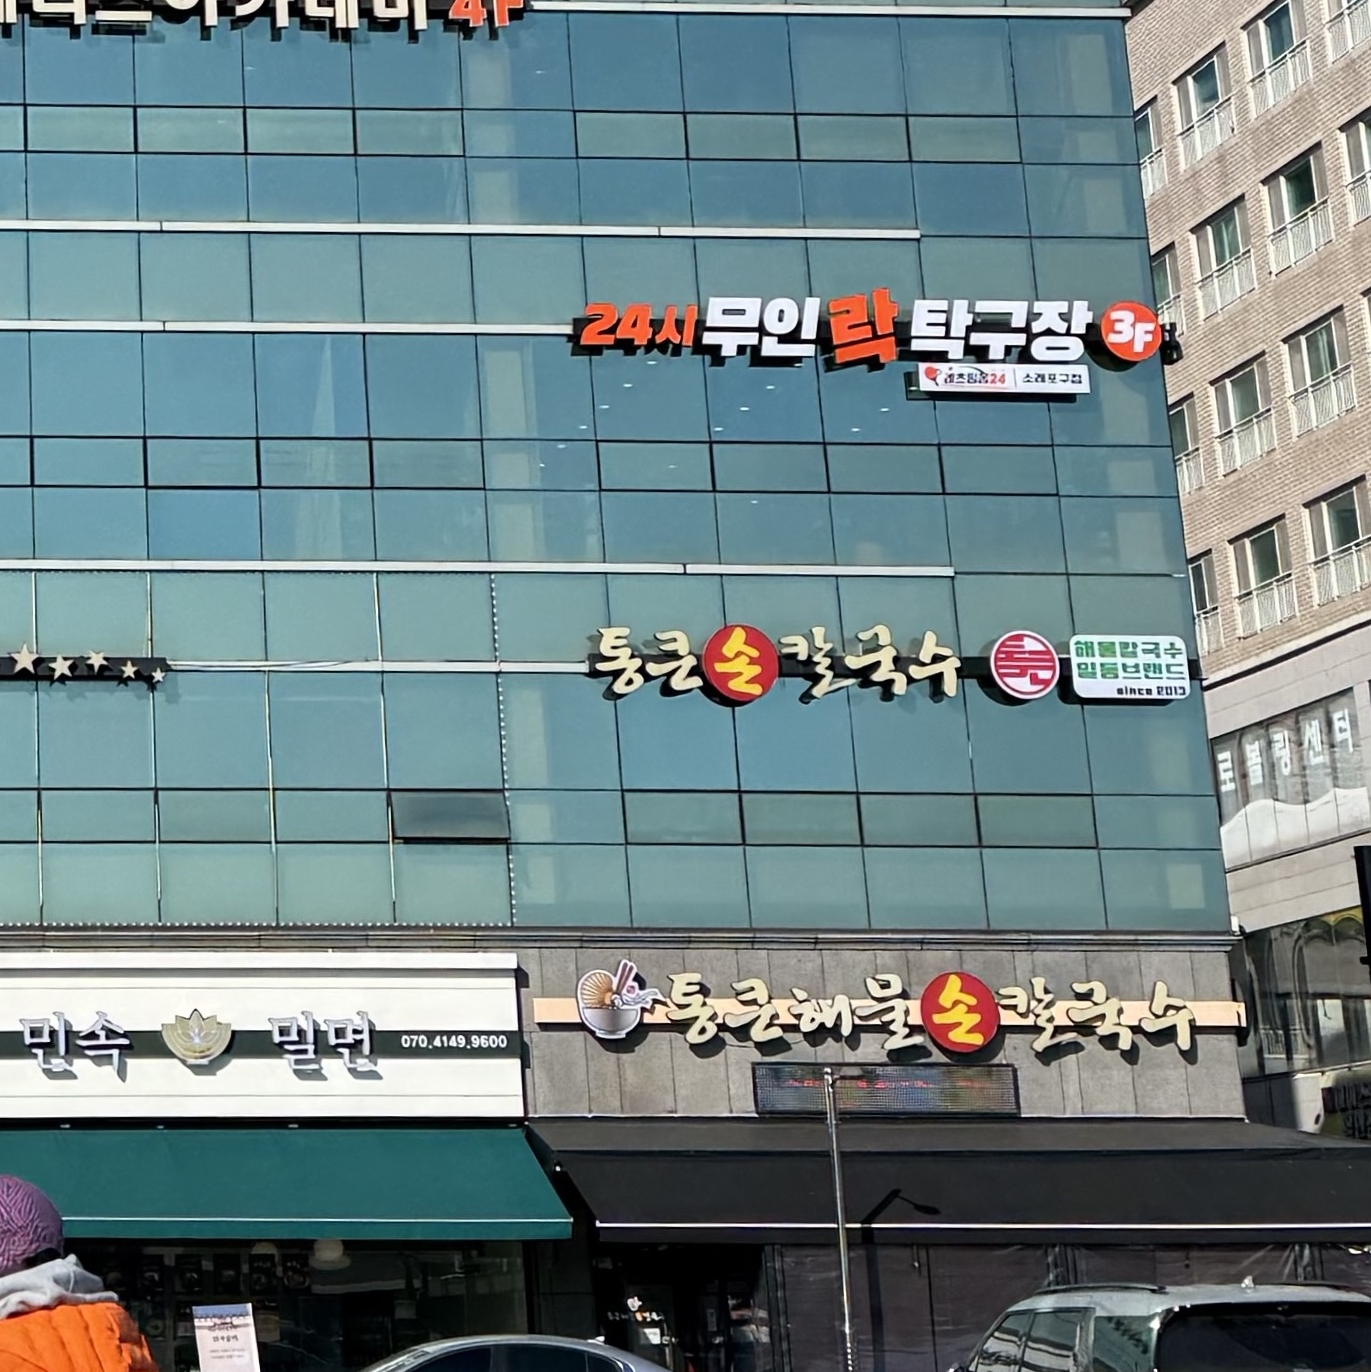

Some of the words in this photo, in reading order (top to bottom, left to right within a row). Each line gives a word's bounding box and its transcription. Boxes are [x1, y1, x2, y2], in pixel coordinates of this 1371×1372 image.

[580, 303, 697, 348] 24시
[701, 296, 820, 357] 무인
[911, 299, 1093, 362] 탁구장
[1106, 308, 1157, 357] 3F
[268, 1010, 376, 1073] 밀면
[400, 1034, 508, 1049] 070.4149.9600
